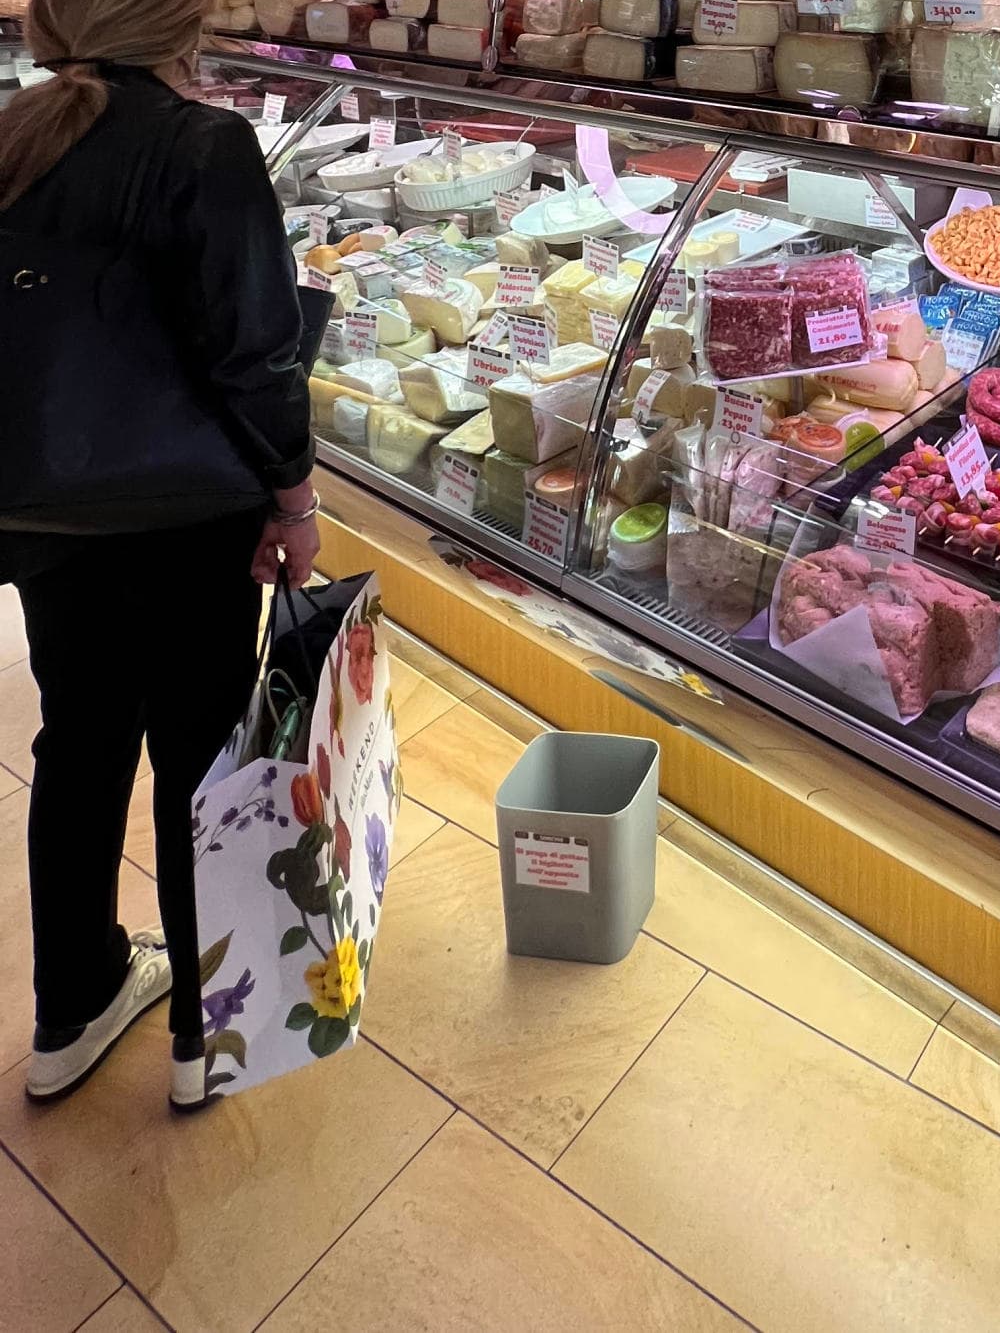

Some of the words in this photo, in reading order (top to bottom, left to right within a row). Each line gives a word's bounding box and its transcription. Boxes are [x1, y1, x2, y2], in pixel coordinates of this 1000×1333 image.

[503, 271, 532, 281] Fontina
[818, 333, 847, 345] 21,80
[473, 358, 508, 374] Ubriaco
